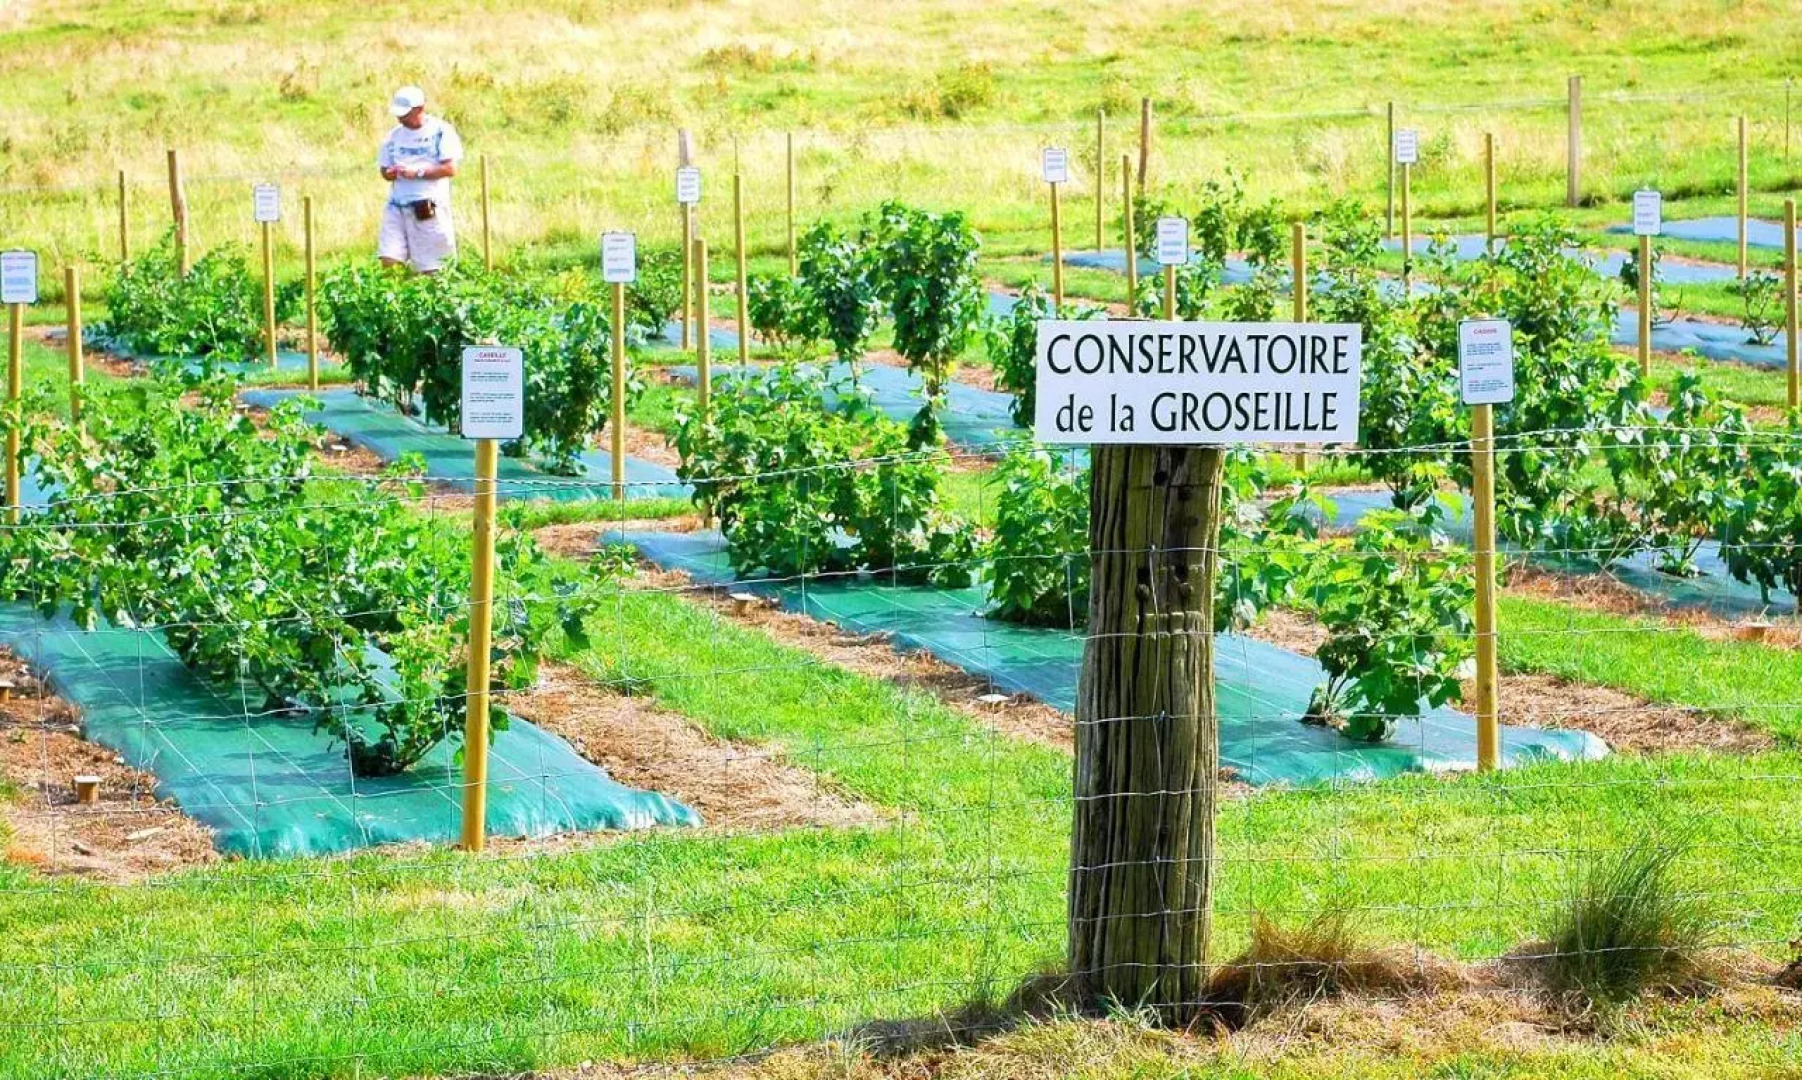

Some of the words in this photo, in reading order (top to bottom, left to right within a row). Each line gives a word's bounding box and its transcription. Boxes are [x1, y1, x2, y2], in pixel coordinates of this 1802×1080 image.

[1047, 334, 1350, 375] CONSERVATOIRE
[1055, 393, 1094, 433] de
[1110, 393, 1134, 432] la
[1150, 392, 1338, 432] GROSEILLE
